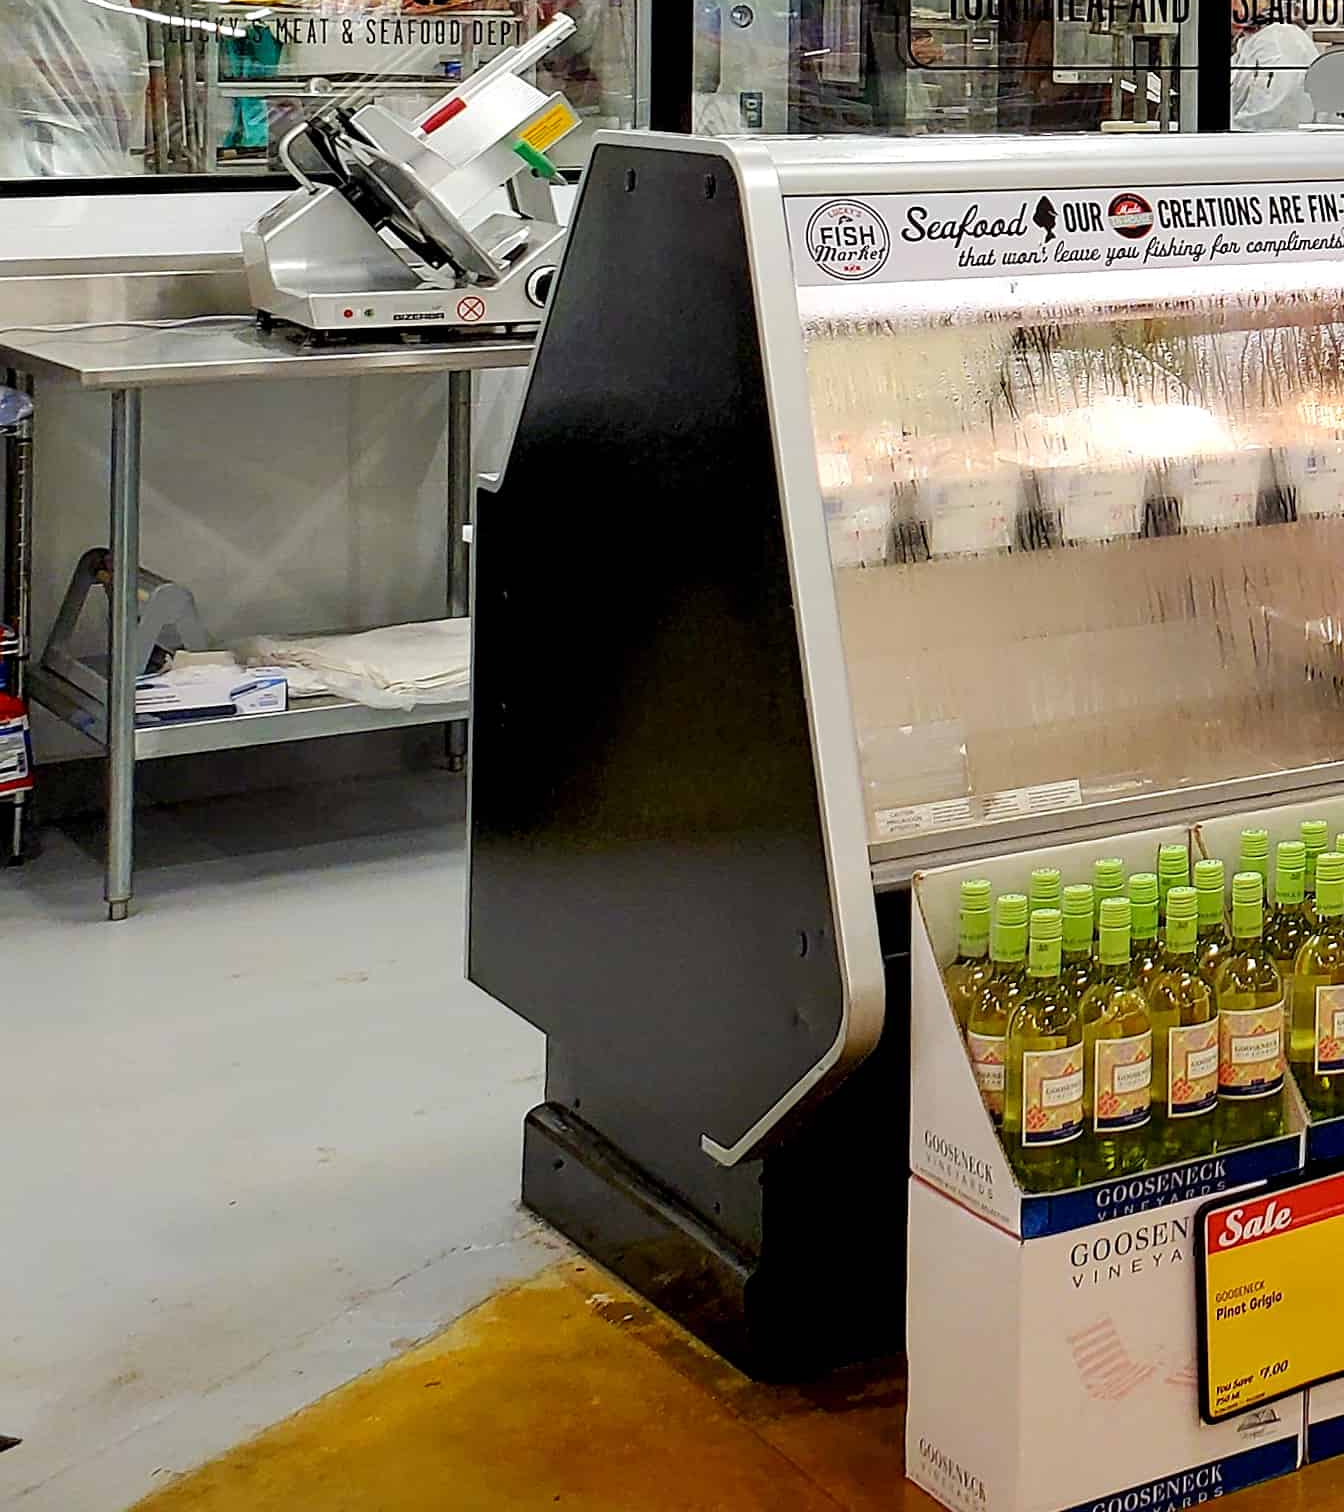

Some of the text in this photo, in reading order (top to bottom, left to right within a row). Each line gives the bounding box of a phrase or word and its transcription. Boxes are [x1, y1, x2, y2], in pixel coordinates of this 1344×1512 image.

[277, 17, 328, 45] MEAT
[342, 19, 353, 44] &
[367, 18, 462, 46] SEAFOOD
[820, 224, 875, 247] FISH
[901, 202, 1028, 249] Seafood
[1062, 201, 1105, 233] OUR
[1157, 195, 1263, 230] CREATIONS
[1267, 194, 1303, 226] ARE
[814, 244, 886, 264] Market
[958, 249, 995, 268] that
[1053, 243, 1100, 265] leave
[1105, 244, 1140, 266] you
[1143, 237, 1207, 264] fishing
[1210, 236, 1240, 264] for
[924, 1129, 993, 1185] GOOSENECK
[1096, 1159, 1226, 1207] GOOSENECK
[1097, 1181, 1226, 1222] VINEYARDS
[1070, 1216, 1193, 1268] GOOSEN
[1219, 1200, 1292, 1247] Sale
[1072, 1248, 1182, 1289] VINEYA
[1215, 1280, 1265, 1304] GOOSENECK
[1216, 1291, 1282, 1321] Pinot Grigio
[919, 1438, 986, 1502] GOOSENECK
[1092, 1464, 1223, 1512] GOOSENECK
